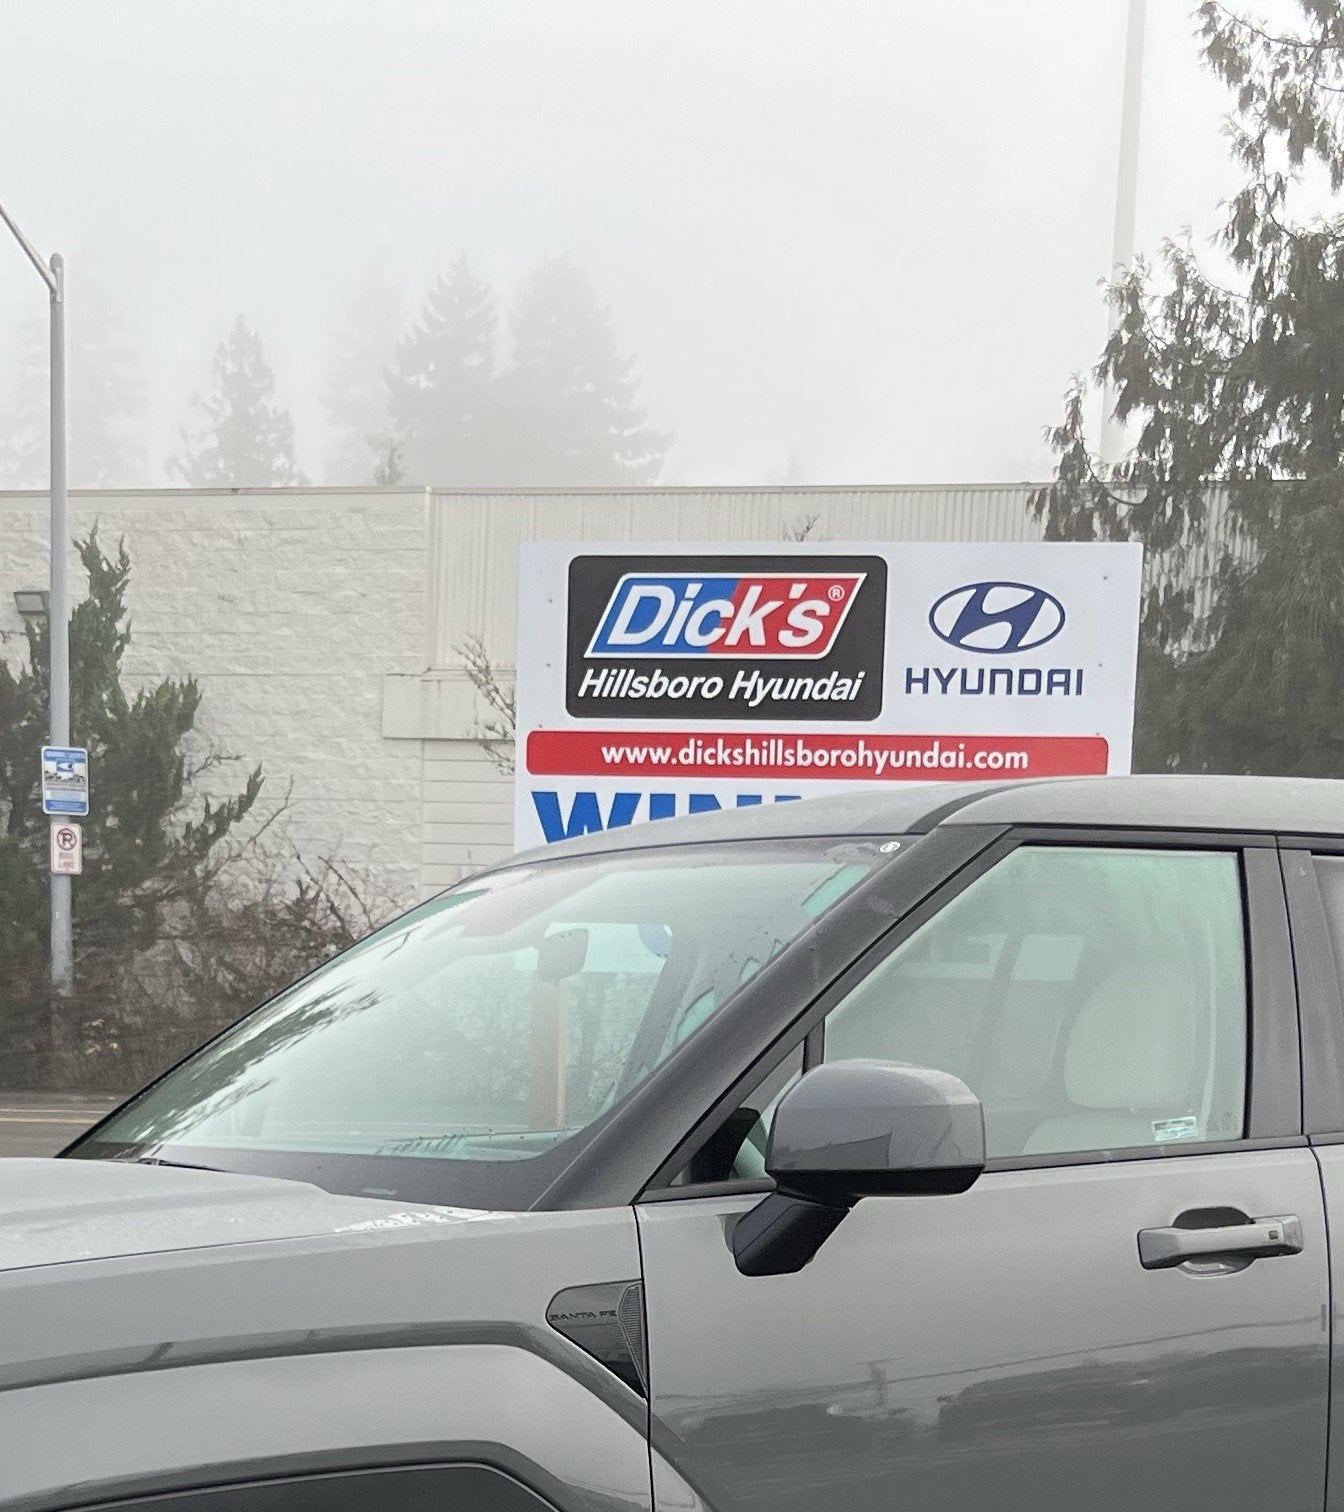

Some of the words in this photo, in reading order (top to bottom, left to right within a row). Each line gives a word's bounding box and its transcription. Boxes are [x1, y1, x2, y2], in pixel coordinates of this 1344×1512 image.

[577, 669, 723, 700] Hillsboro
[727, 670, 866, 706] Hyundai
[904, 666, 1084, 697] HYUNDAI
[601, 738, 1029, 775] www.dickshillsborohyundai.com
